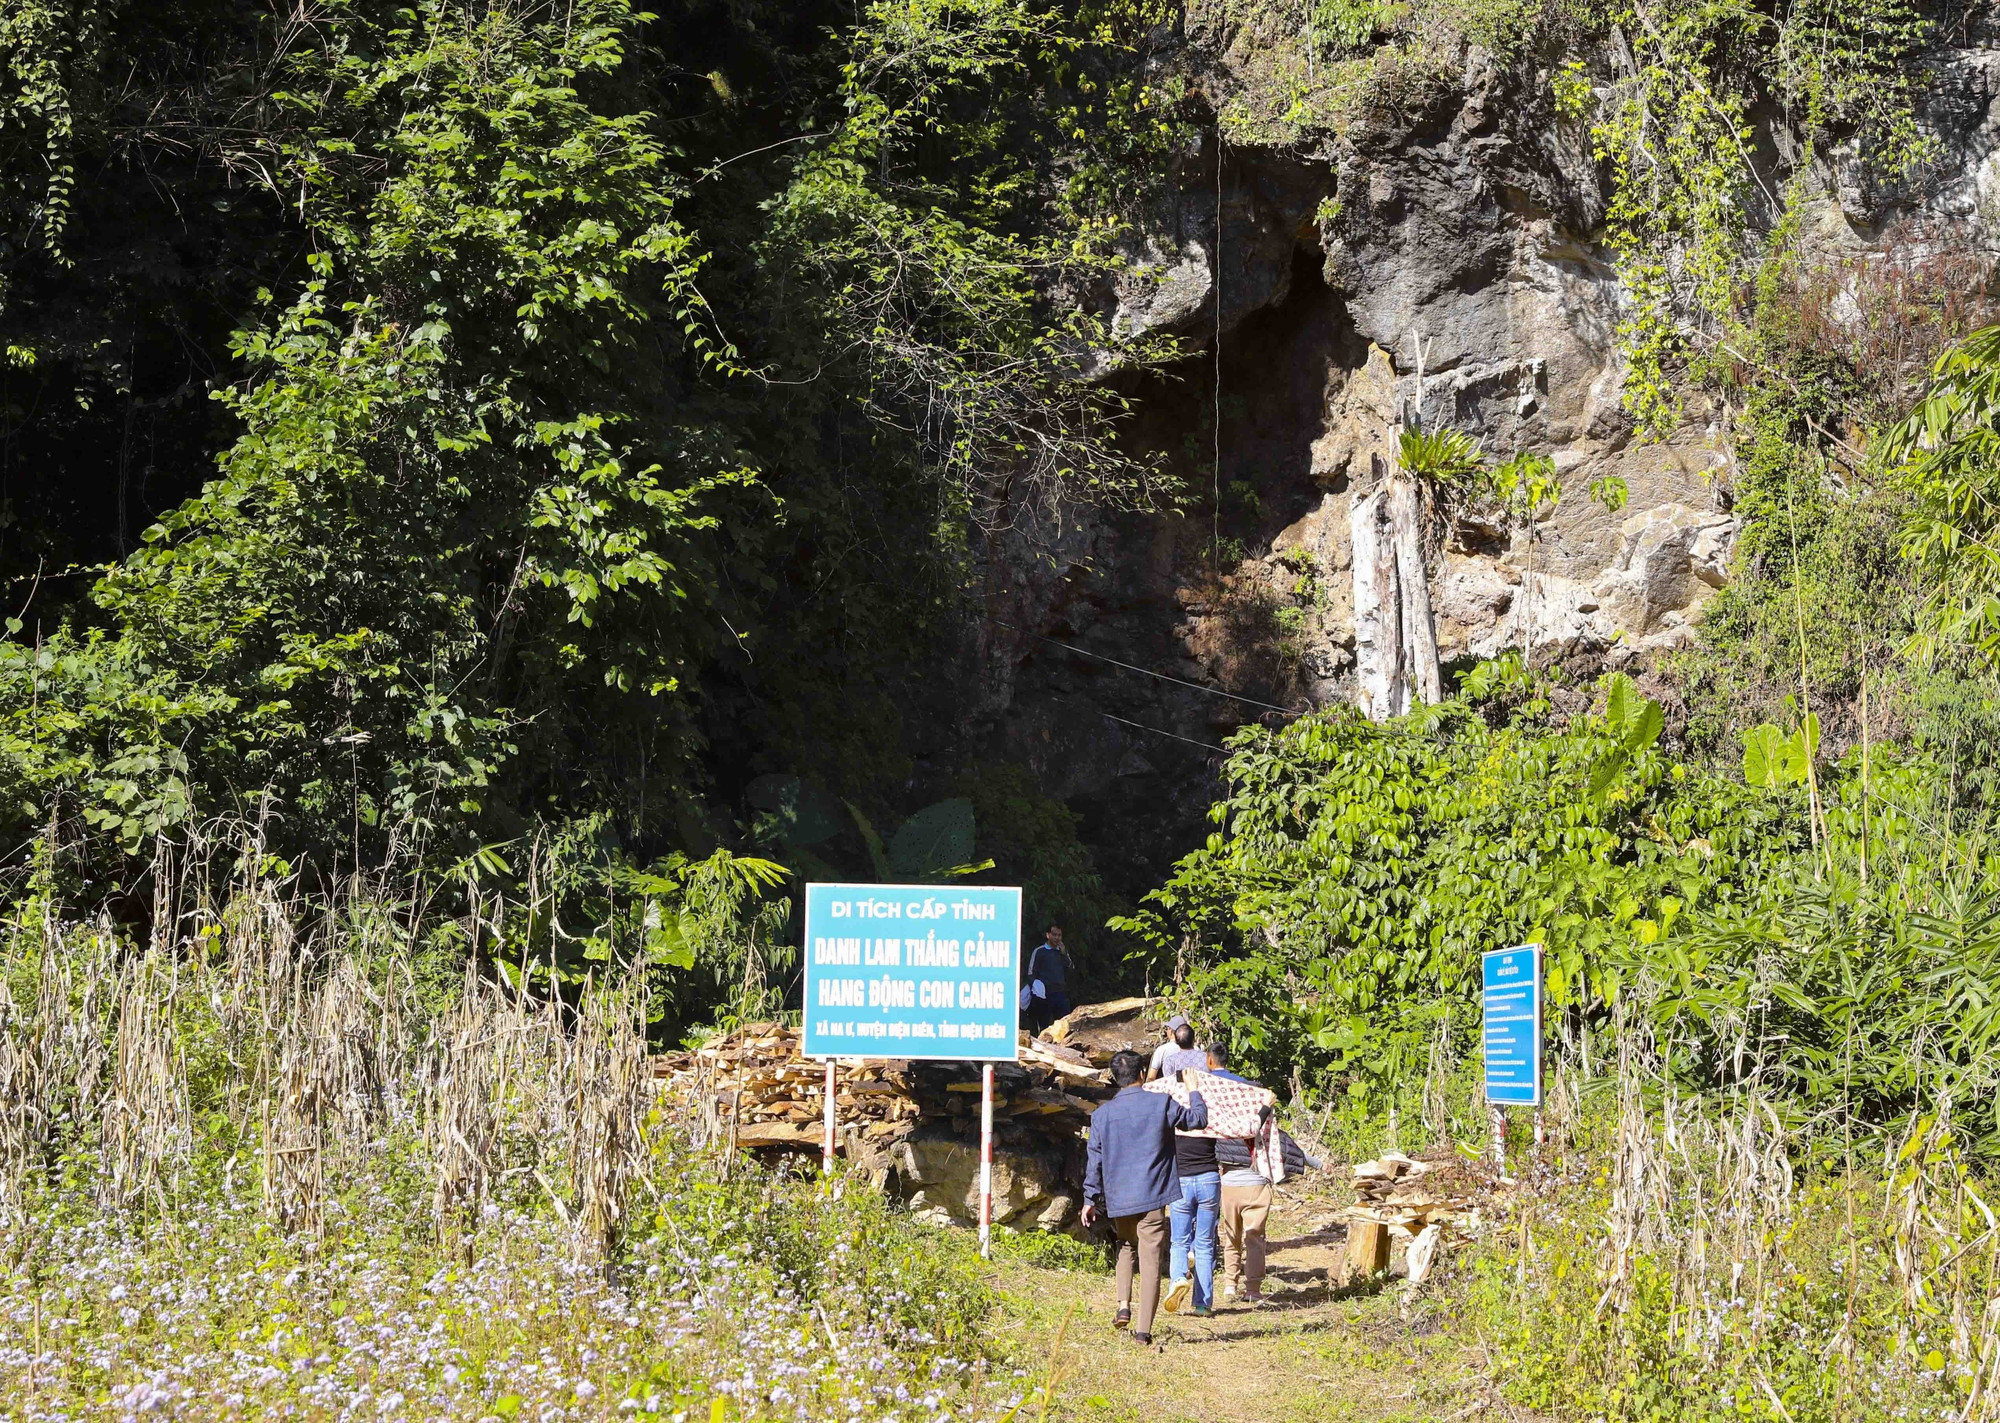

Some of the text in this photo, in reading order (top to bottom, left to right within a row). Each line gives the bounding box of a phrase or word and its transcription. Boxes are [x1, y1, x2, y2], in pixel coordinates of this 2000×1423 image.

[832, 897, 995, 920] DI TÍCH CẤP TỈNH
[815, 929, 1010, 967] DANH LAM THẮNG CẢNH
[819, 974, 1004, 1012] HANG ĐỘNG CON CANG
[831, 1023, 843, 1035] NA
